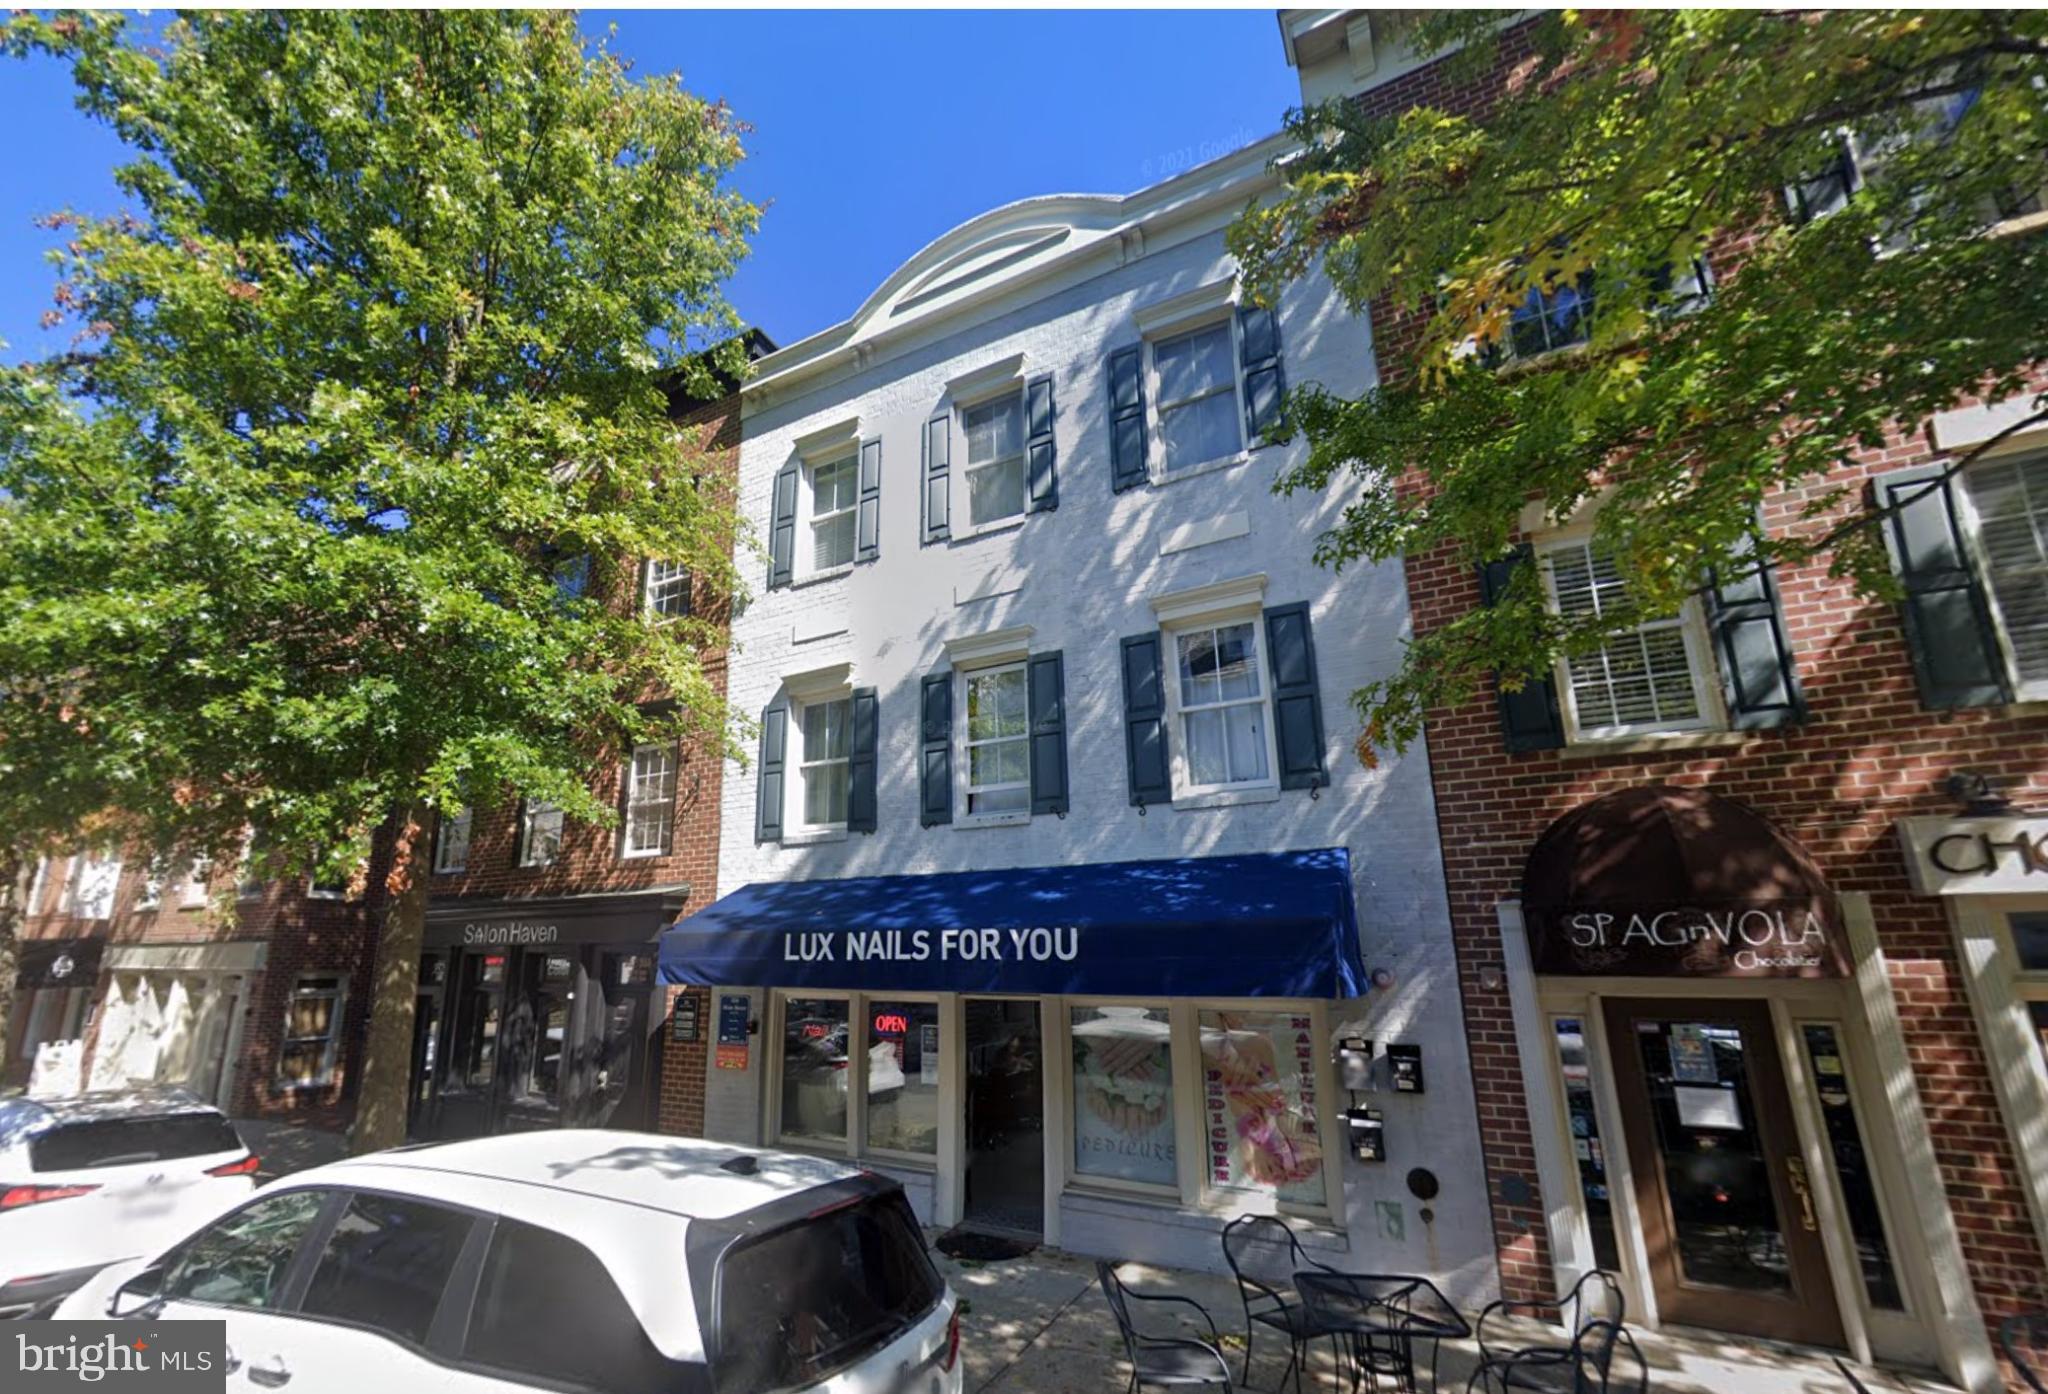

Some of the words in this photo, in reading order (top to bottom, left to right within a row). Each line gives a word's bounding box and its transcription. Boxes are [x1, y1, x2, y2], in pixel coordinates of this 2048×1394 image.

[510, 922, 558, 943] Haven
[784, 932, 834, 961] LUX
[846, 930, 930, 961] NAILS
[941, 928, 1001, 961] FOR
[1009, 927, 1077, 961] YOU
[874, 1014, 907, 1033] OPEN
[1207, 1070, 1230, 1182] PEDICURE
[1082, 1136, 1176, 1162] PEDICURE
